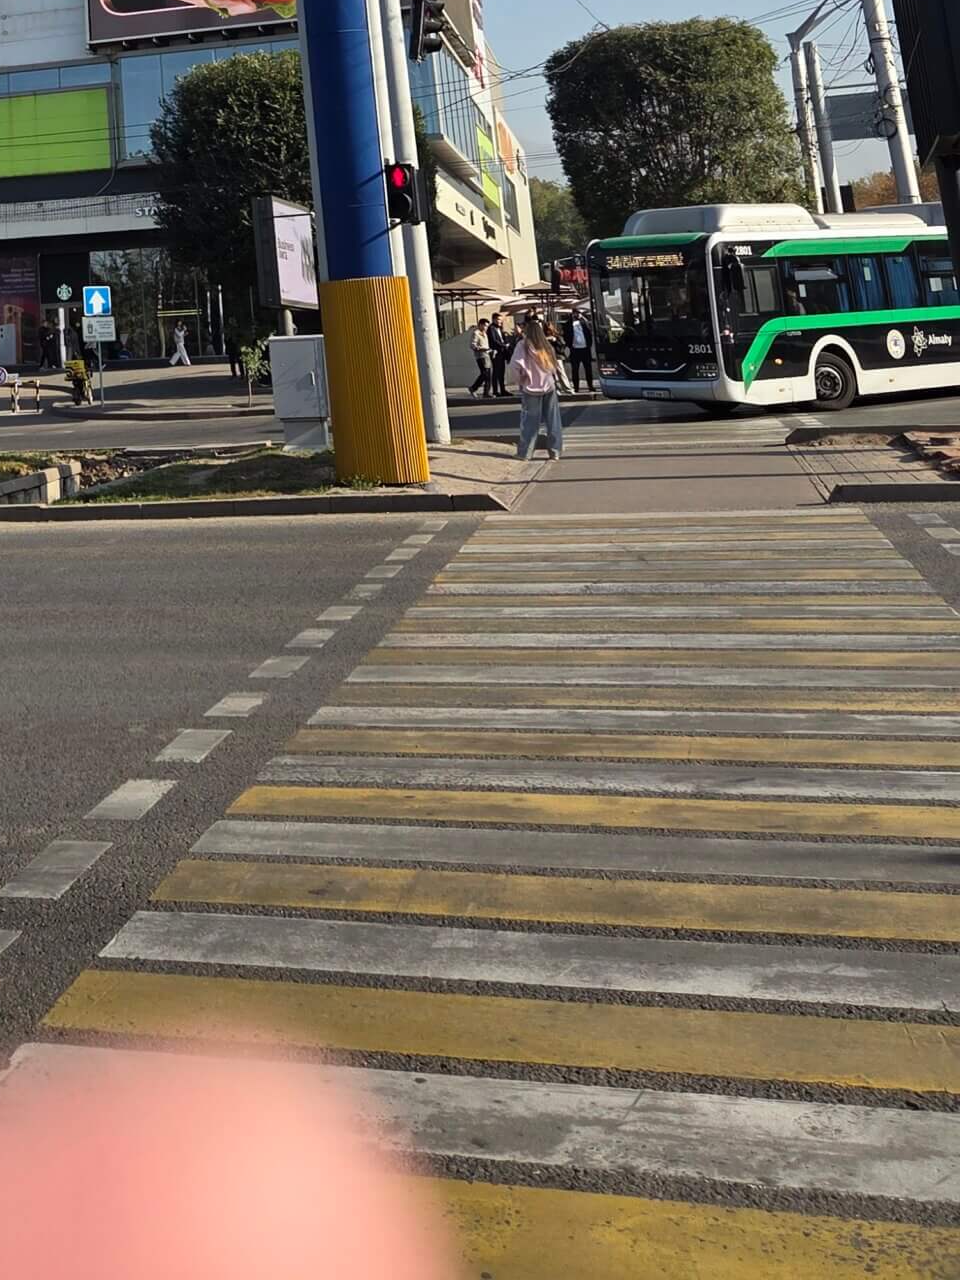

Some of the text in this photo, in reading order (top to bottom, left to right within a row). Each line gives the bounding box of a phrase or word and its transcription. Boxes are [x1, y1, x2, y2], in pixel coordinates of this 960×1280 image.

[734, 245, 753, 256] 2801
[928, 333, 952, 346] Almaty
[688, 343, 713, 354] 2801
